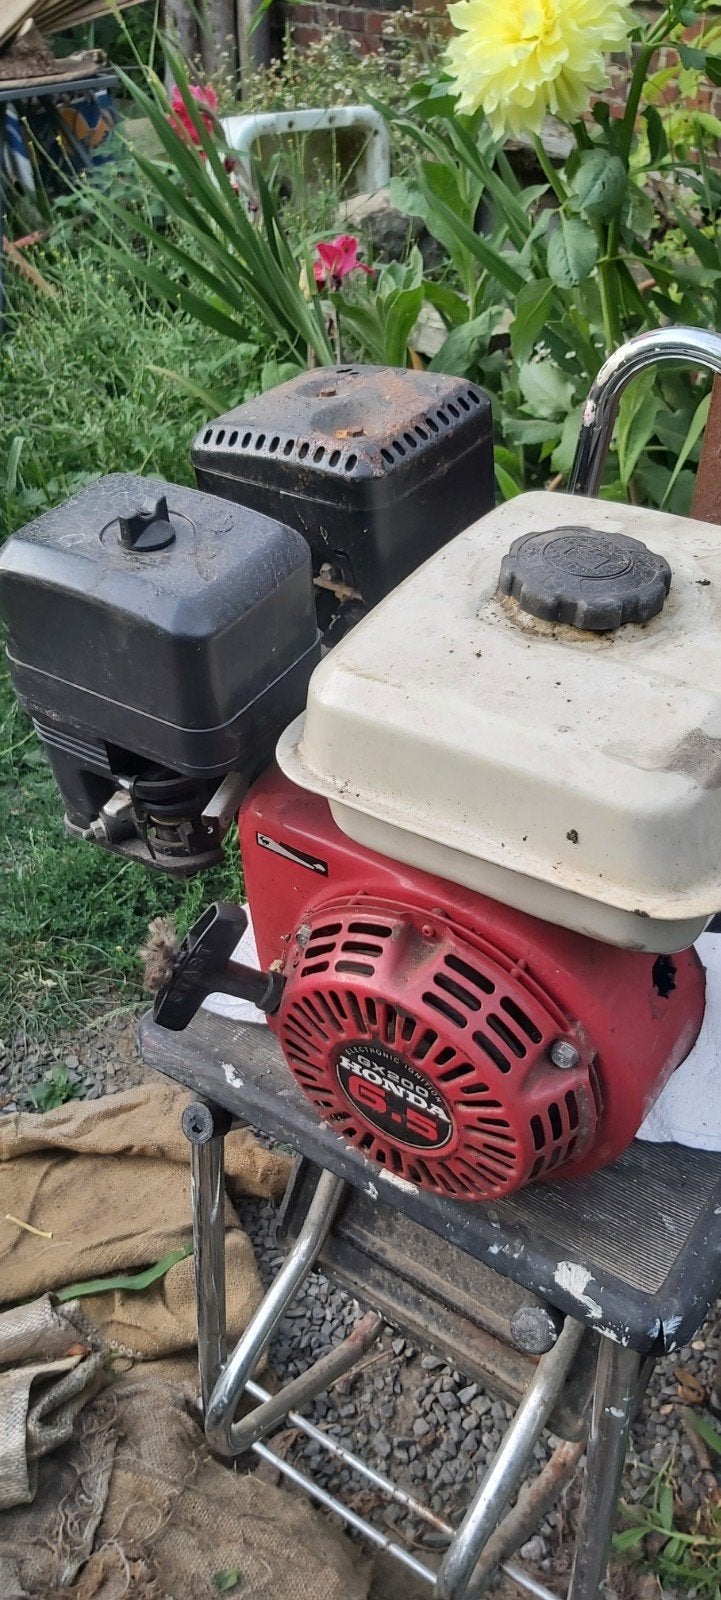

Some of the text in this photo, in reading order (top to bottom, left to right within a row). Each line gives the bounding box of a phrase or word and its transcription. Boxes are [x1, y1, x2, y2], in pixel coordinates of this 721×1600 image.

[169, 944, 213, 1003] START
[340, 1055, 451, 1123] HONDA
[345, 1046, 443, 1102] ELECTRONIC IGNITION
[357, 1055, 428, 1098] GX200
[348, 1075, 438, 1141] 6.5
